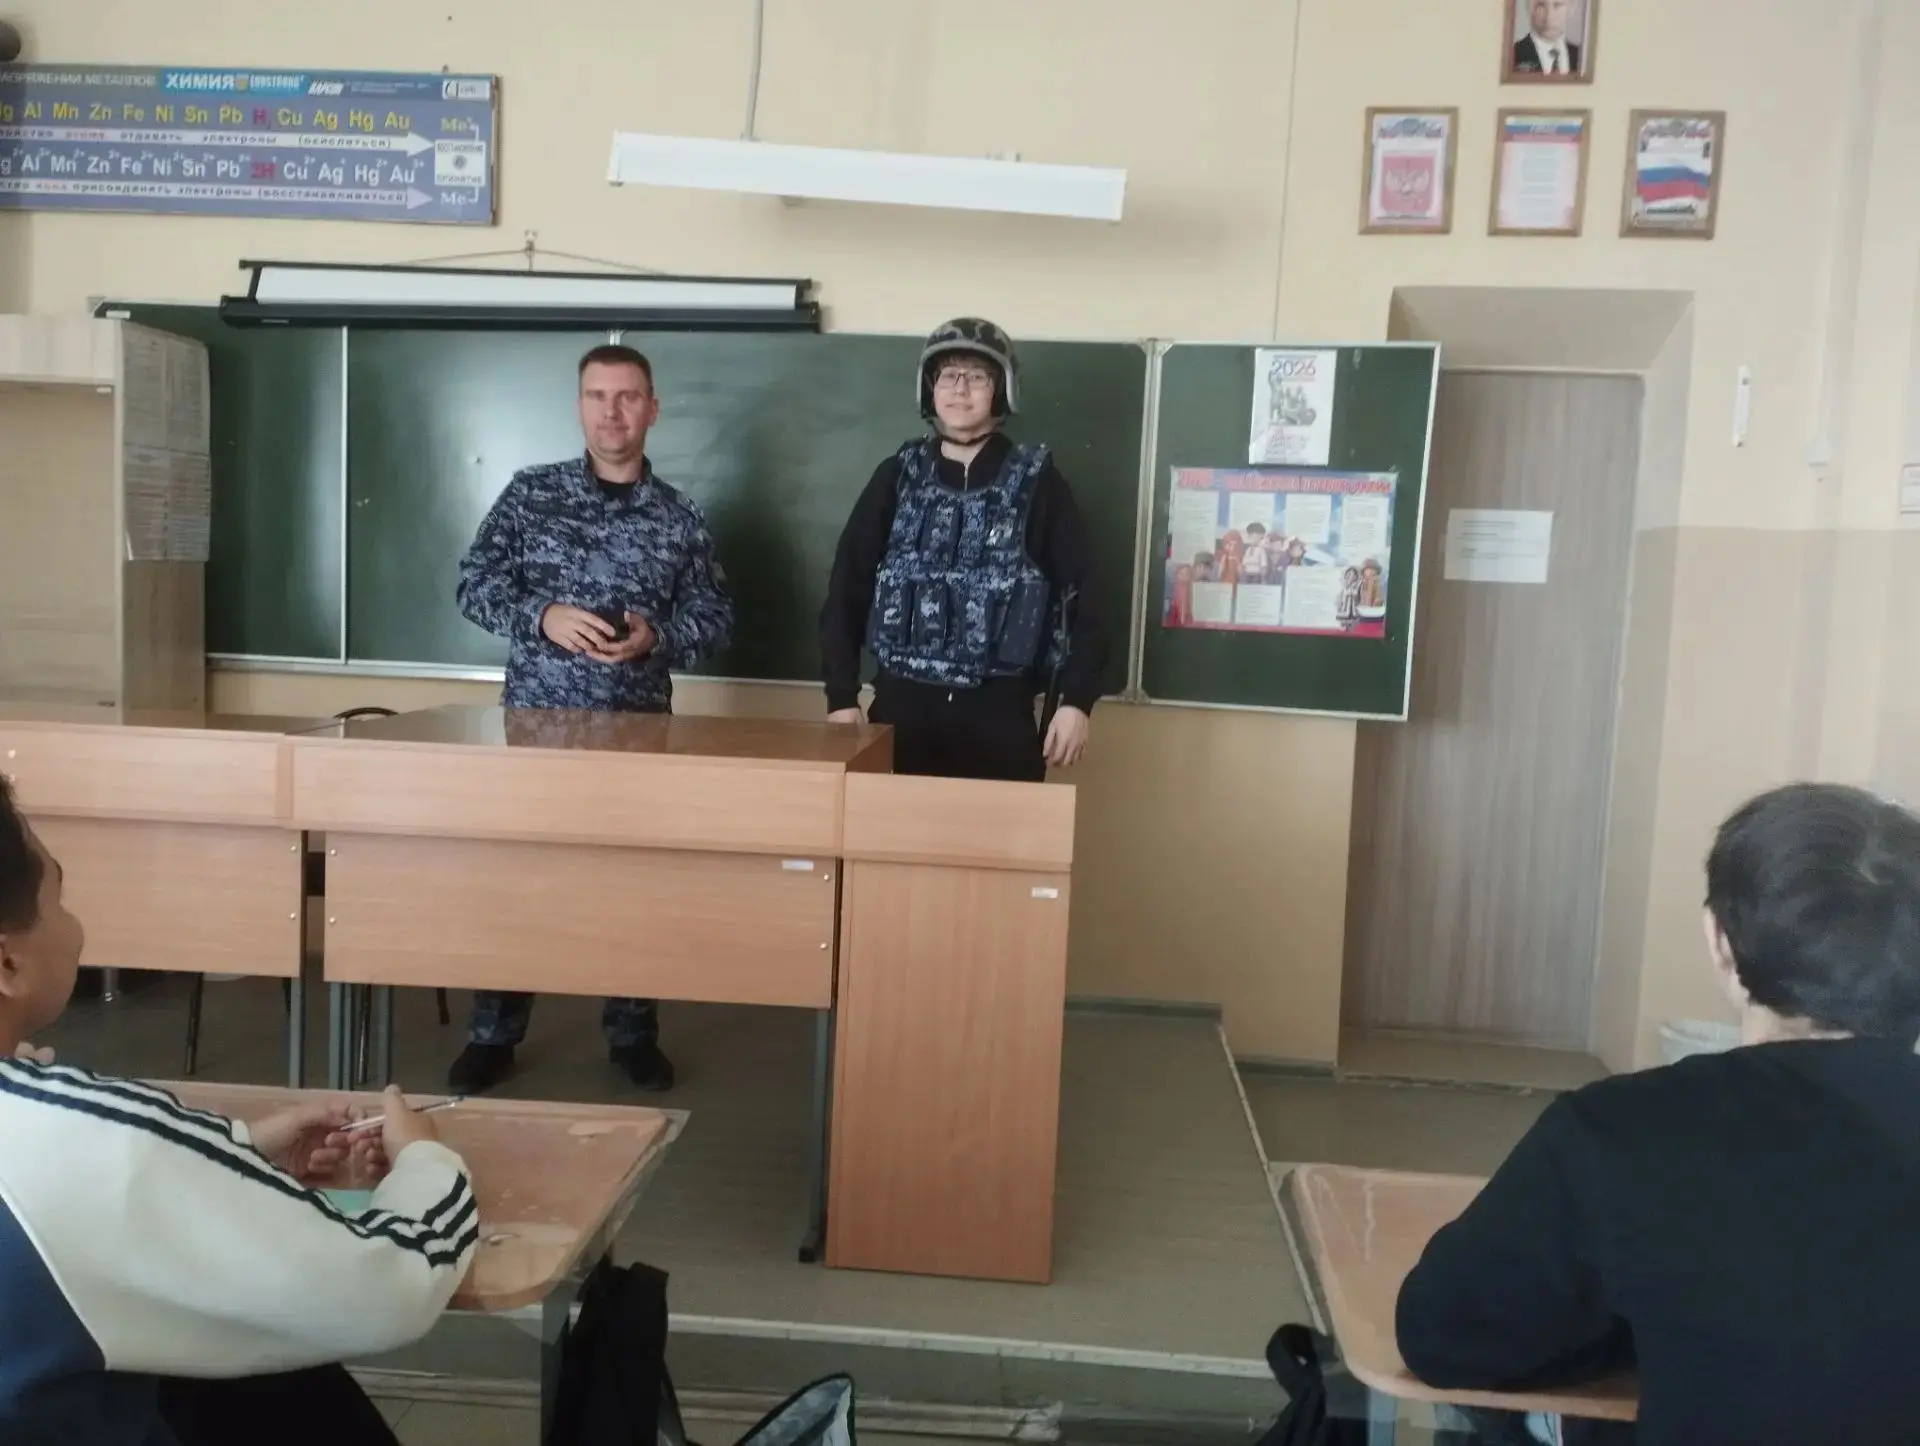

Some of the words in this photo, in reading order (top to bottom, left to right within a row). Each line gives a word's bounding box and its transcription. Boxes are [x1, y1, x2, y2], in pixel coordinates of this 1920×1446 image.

[166, 73, 235, 91] ХИМИЯ
[0, 103, 14, 123] g
[24, 101, 42, 119] Al
[53, 102, 79, 120] Mn
[89, 103, 112, 121] Zn
[123, 104, 145, 122] Fe
[155, 104, 174, 123] Ni
[185, 105, 208, 124] Sn
[219, 106, 244, 125] Pb
[277, 108, 303, 126] Cu
[313, 109, 338, 130] Ag
[349, 109, 374, 133] Hg
[384, 111, 410, 130] Au
[1272, 360, 1317, 377] 2026
